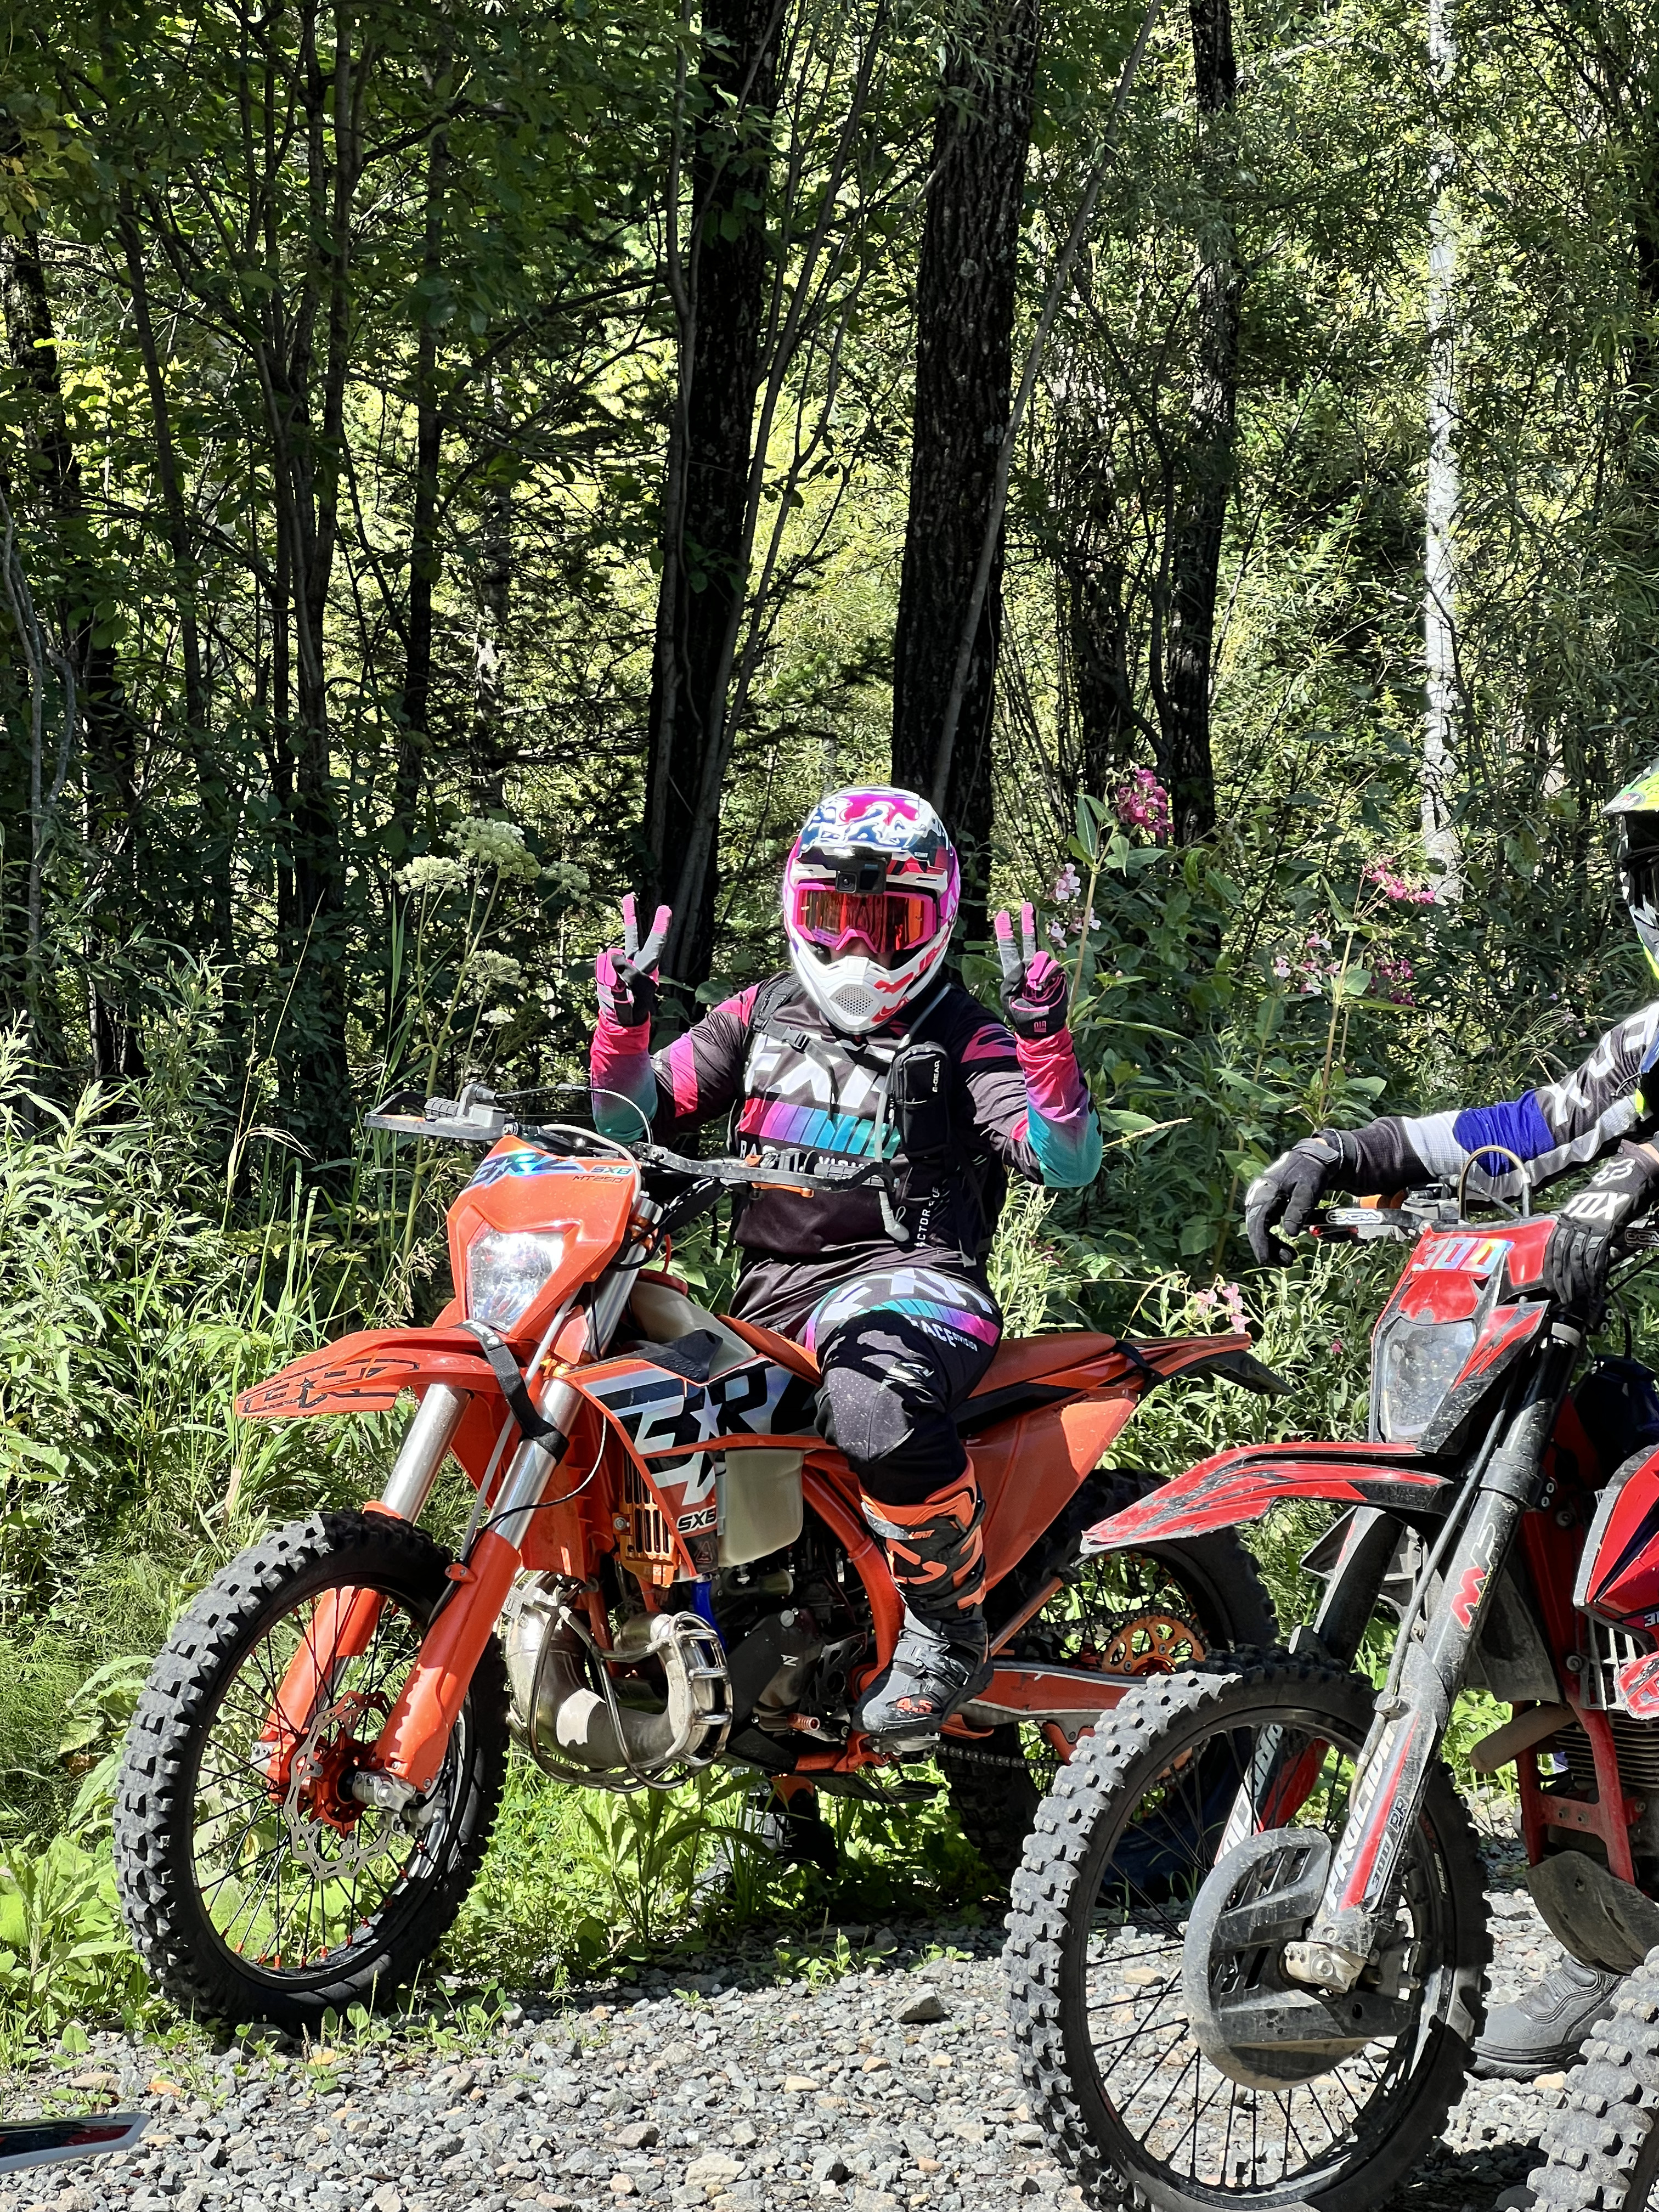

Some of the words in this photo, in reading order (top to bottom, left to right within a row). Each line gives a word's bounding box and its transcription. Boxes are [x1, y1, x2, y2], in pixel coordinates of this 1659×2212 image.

[932, 1060, 940, 1092] E-GEAR
[572, 1175, 624, 1183] MT250
[1564, 1192, 1630, 1220] FOX
[1412, 1236, 1516, 1275] 300
[897, 1697, 933, 1713] 4.5
[1388, 1796, 1409, 1833] PR
